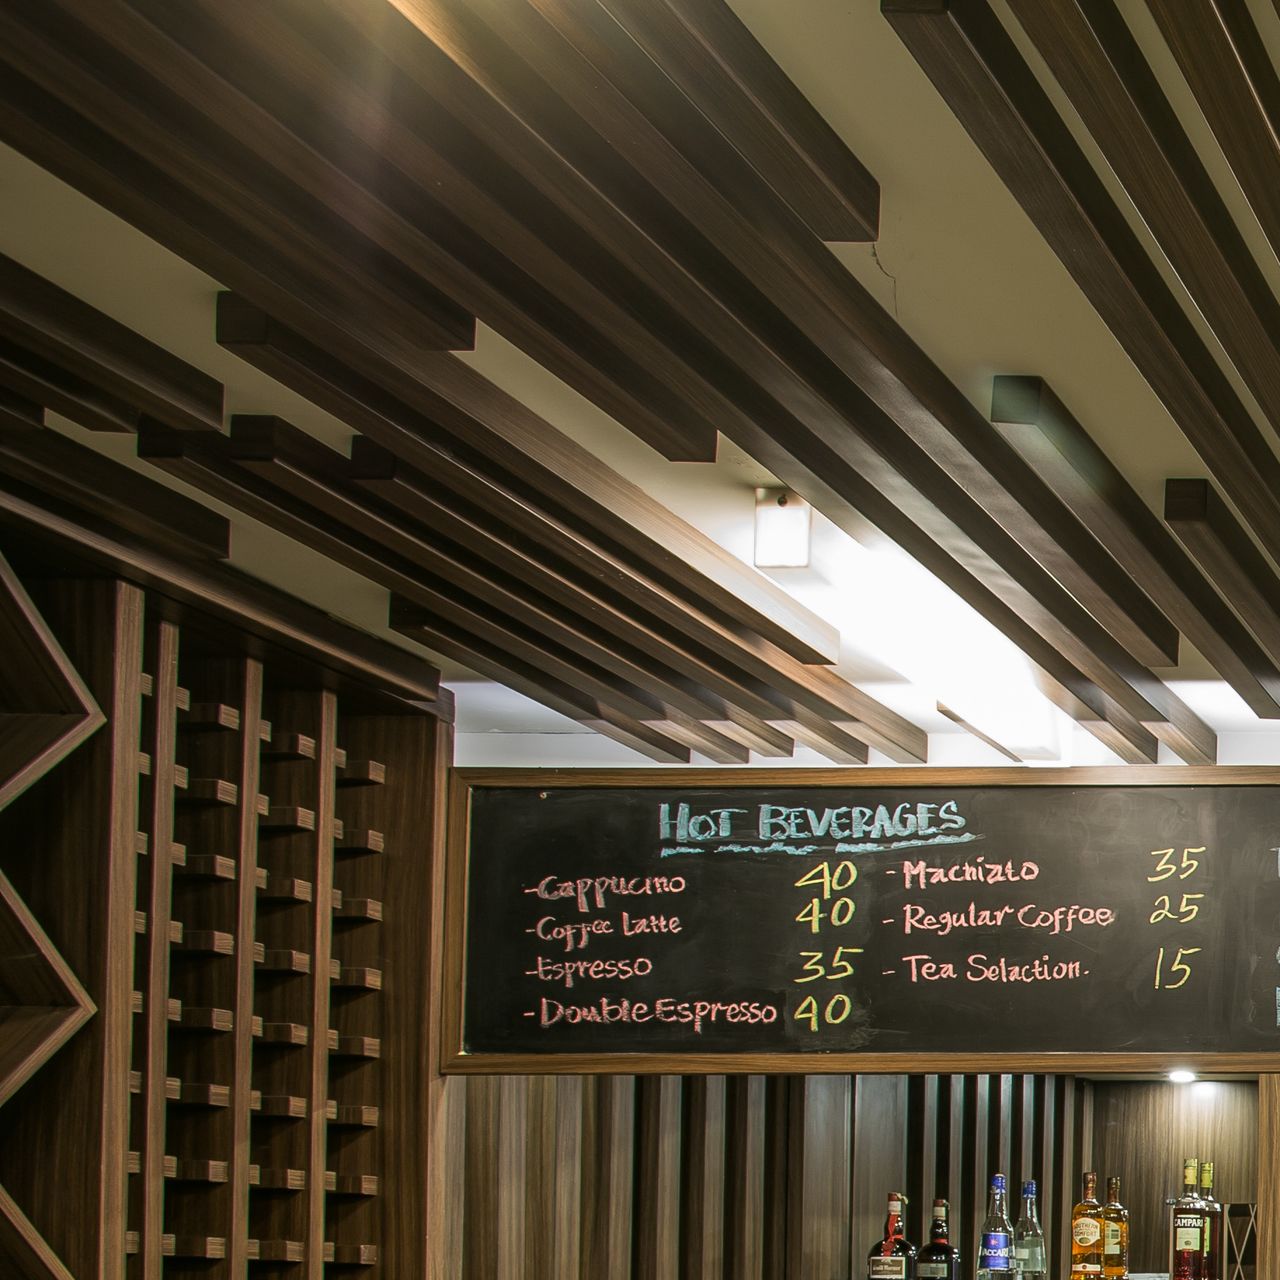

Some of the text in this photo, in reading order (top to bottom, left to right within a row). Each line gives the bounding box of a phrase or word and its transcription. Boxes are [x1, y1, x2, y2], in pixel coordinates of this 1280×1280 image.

[660, 800, 967, 843] HOT BEVERAGES
[794, 861, 858, 899] 40
[1148, 847, 1206, 882] 35
[622, 911, 683, 936] Latte
[795, 897, 857, 933] 40
[903, 902, 1116, 936] Regular Coffee
[1149, 893, 1205, 924] 25
[794, 946, 864, 983] 35
[902, 954, 957, 983] Tea
[1154, 947, 1203, 990] 15
[540, 997, 778, 1034] Double Espresso
[794, 993, 852, 1031] 40
